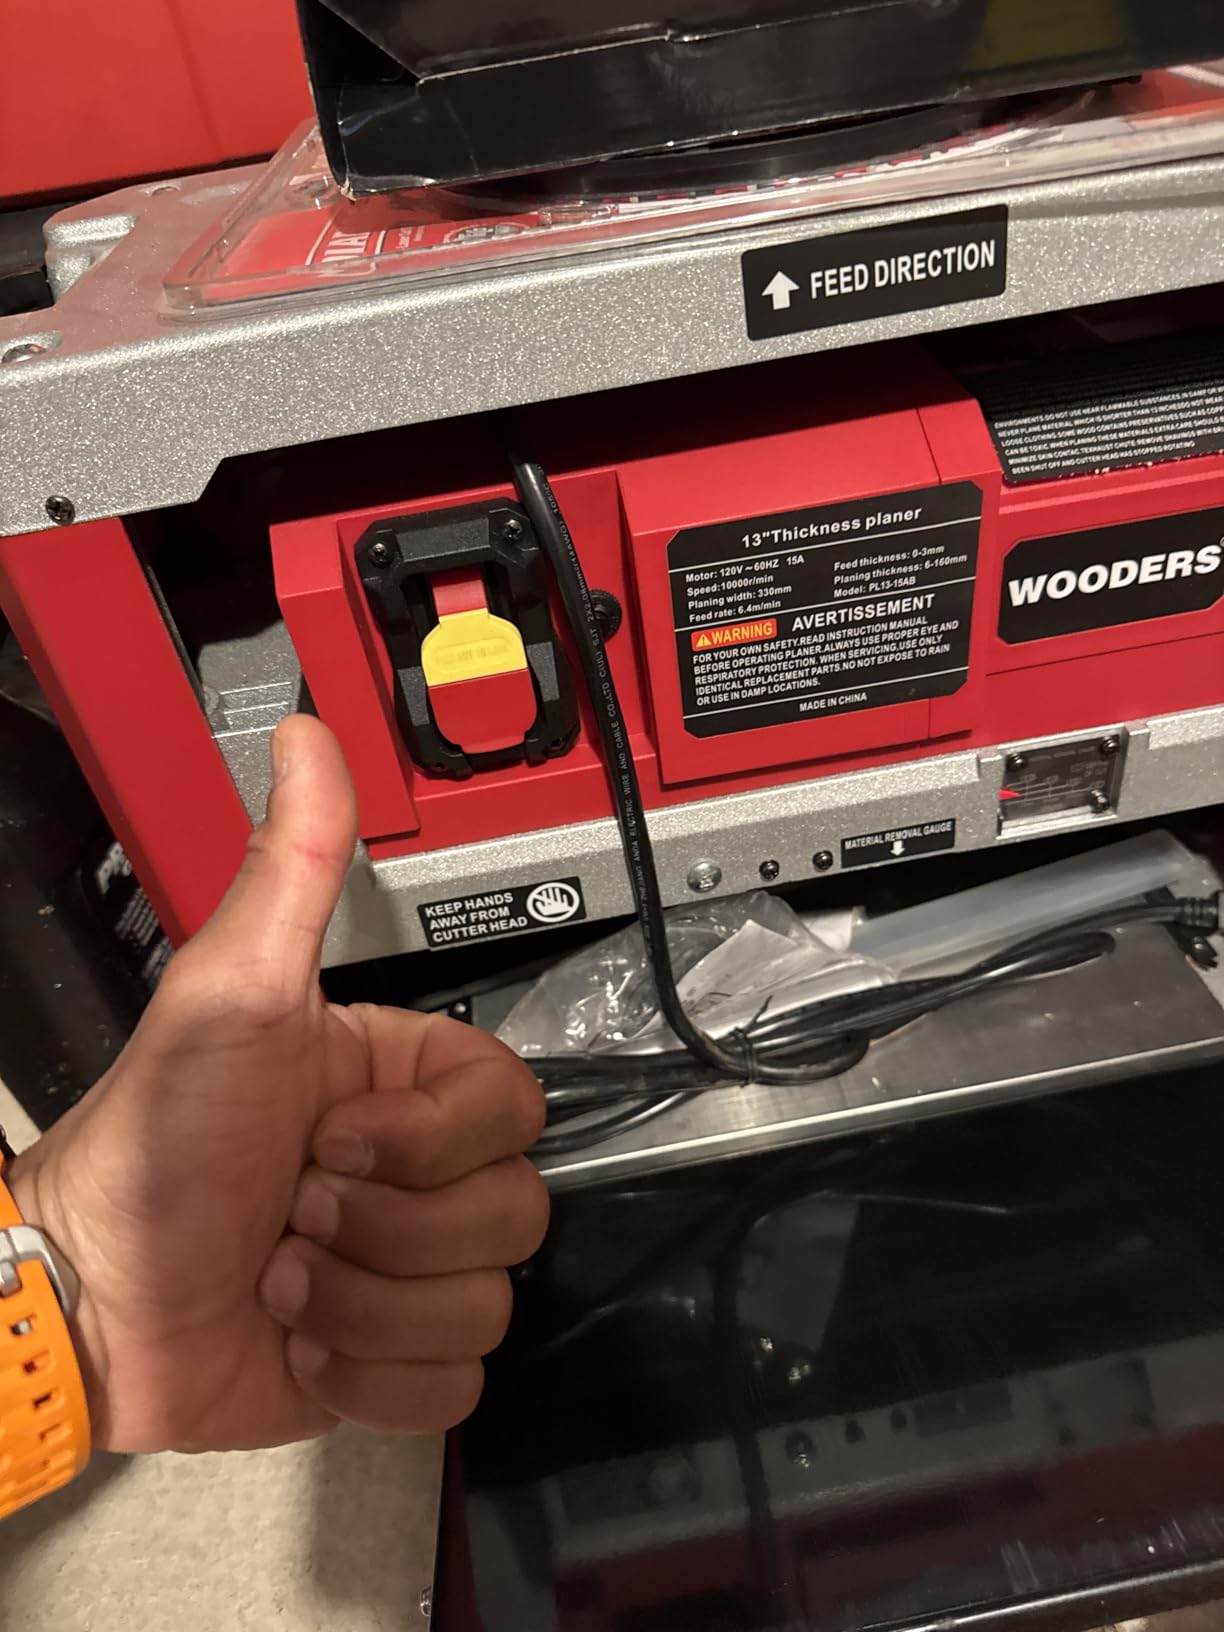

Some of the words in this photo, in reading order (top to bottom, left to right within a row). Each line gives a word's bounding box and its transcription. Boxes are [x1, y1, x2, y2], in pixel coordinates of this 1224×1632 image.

[811, 264, 868, 299] FEED
[874, 240, 995, 287] DIRECTION
[865, 505, 921, 530] planer
[685, 569, 717, 583] Motor:
[786, 554, 804, 565] 15A
[833, 559, 857, 571] Feed
[859, 549, 910, 567] thickness:
[912, 544, 944, 558] 0-3mm
[833, 570, 871, 586] Planing
[872, 561, 922, 578] thickness:
[924, 553, 967, 569] 6-160mm
[1008, 544, 1221, 607] WOODERS
[687, 595, 724, 611] Planing
[726, 590, 755, 604] width:
[757, 583, 791, 597] 330mm
[833, 584, 865, 598] Model:
[689, 611, 712, 622] Feed
[713, 607, 736, 618] rate:
[737, 599, 781, 614] 6.4m/min
[791, 592, 935, 631] AVERTISSEMENT
[692, 652, 712, 664] FOR
[712, 648, 739, 661] YOUR
[739, 644, 761, 656] OWN
[826, 622, 888, 641] INSTRUCTION
[888, 615, 928, 630] MANUAL
[693, 660, 730, 675] BEFORE
[731, 651, 784, 668] OPERATING
[861, 634, 880, 645] USE
[881, 627, 919, 642] PROPER
[920, 624, 938, 635] EYE
[939, 619, 959, 631] AND
[711, 621, 772, 645] WARNING
[694, 666, 757, 685] RESPIRATORY
[757, 655, 818, 674] PROTECTION.
[819, 650, 846, 663] WHEN
[918, 634, 943, 646] ONLY
[695, 679, 742, 696] IDENTICAL
[743, 668, 809, 687] REPLACEMENT
[857, 656, 875, 668] NOT
[876, 649, 913, 664] EXPOSE
[914, 647, 927, 658] TO
[928, 643, 950, 655] RAIN
[696, 696, 710, 706] OR
[711, 692, 729, 704] USE
[730, 691, 740, 700] IN
[740, 686, 767, 699] DAMP
[767, 676, 820, 694] LOCATIONS.
[799, 699, 826, 712] MADE
[827, 697, 836, 707] IN
[838, 691, 867, 705] CHINA
[611, 720, 623, 748] CABLE
[618, 751, 628, 769] AND
[620, 773, 632, 795] WIRE
[624, 798, 637, 836] ELECTRIC
[844, 834, 883, 849] MATERIAL
[884, 826, 922, 842] REMOVAL
[922, 821, 952, 835] GAUGE
[424, 901, 464, 917] KEEP
[464, 892, 513, 910] HANDS
[427, 913, 471, 930] AWAY
[469, 906, 510, 922] FROM
[431, 923, 488, 943] CUTTER
[488, 915, 528, 932] HEAD
